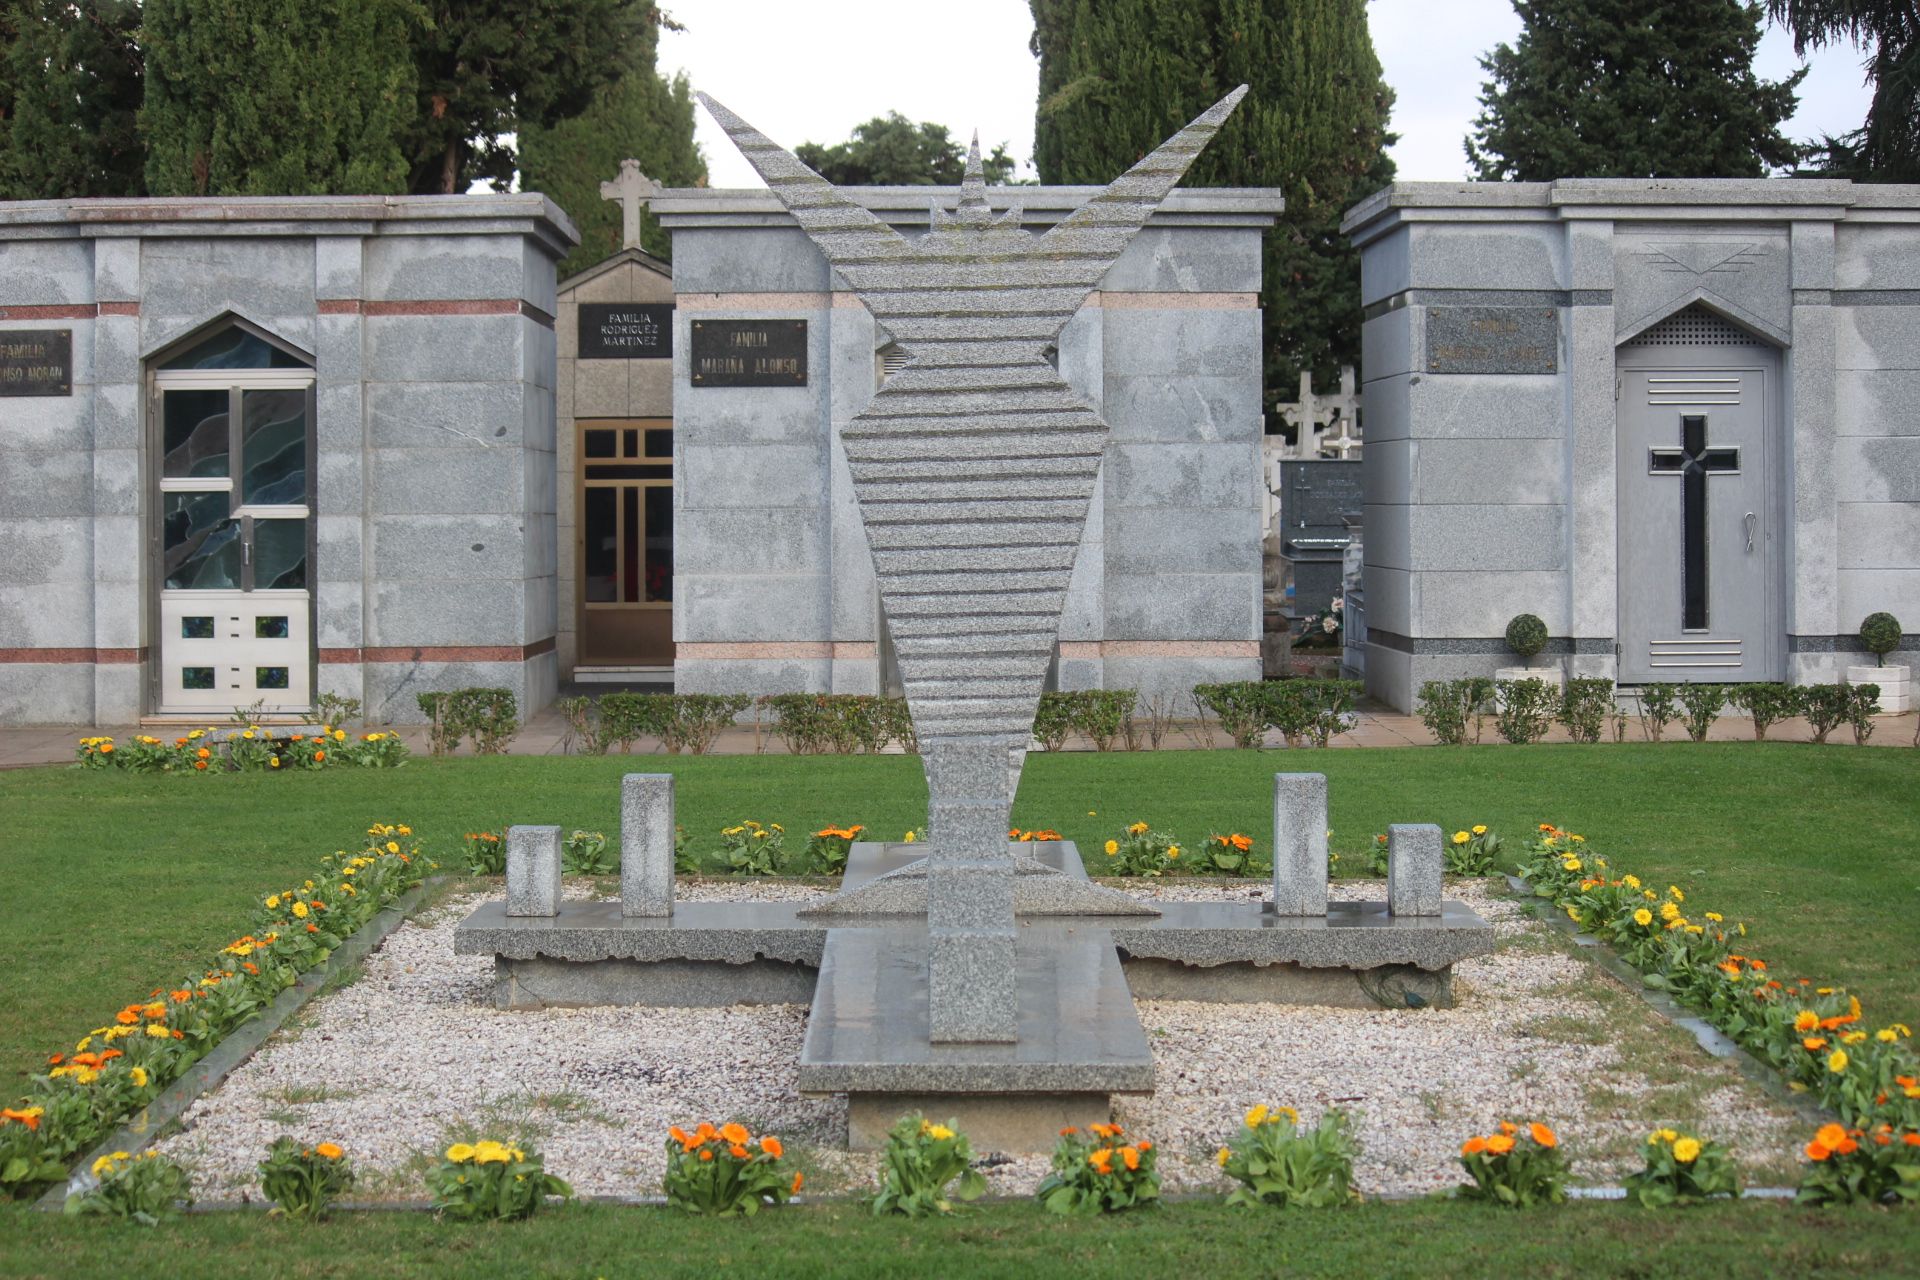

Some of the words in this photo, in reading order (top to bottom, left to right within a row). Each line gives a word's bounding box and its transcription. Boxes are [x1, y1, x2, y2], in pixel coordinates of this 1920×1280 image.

[609, 313, 651, 324] FAMILIA
[601, 324, 658, 335] RODRIGUEZ
[603, 336, 657, 346] MARTINEZ
[730, 331, 768, 348] FAMILIA
[0, 344, 45, 359] FAMILIA
[701, 355, 744, 375] MARAÑA
[755, 358, 797, 375] ALONSO
[28, 366, 63, 382] MORAN
